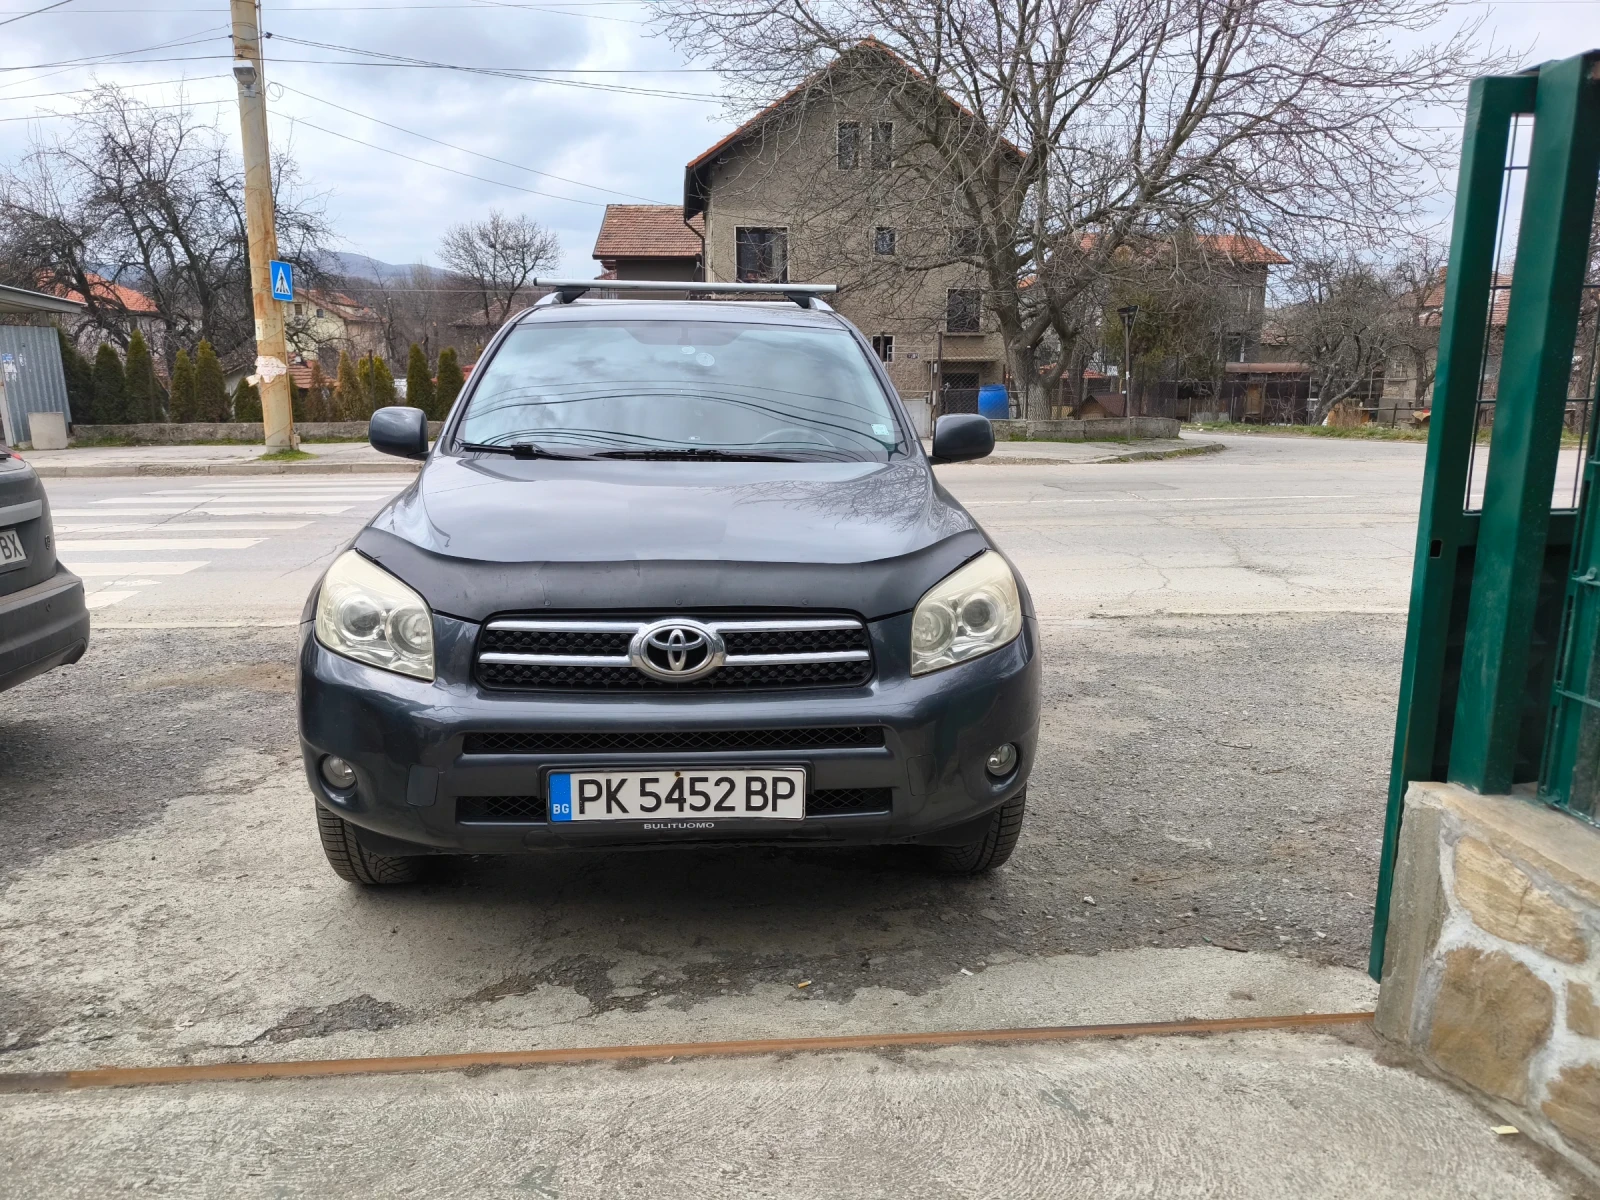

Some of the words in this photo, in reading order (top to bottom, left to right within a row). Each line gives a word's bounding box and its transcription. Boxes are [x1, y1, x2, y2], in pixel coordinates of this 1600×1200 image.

[578, 778, 630, 815] PK
[639, 776, 736, 814] 5452
[745, 776, 796, 813] BP
[552, 803, 570, 815] BG
[643, 822, 715, 830] BULITUOMO
